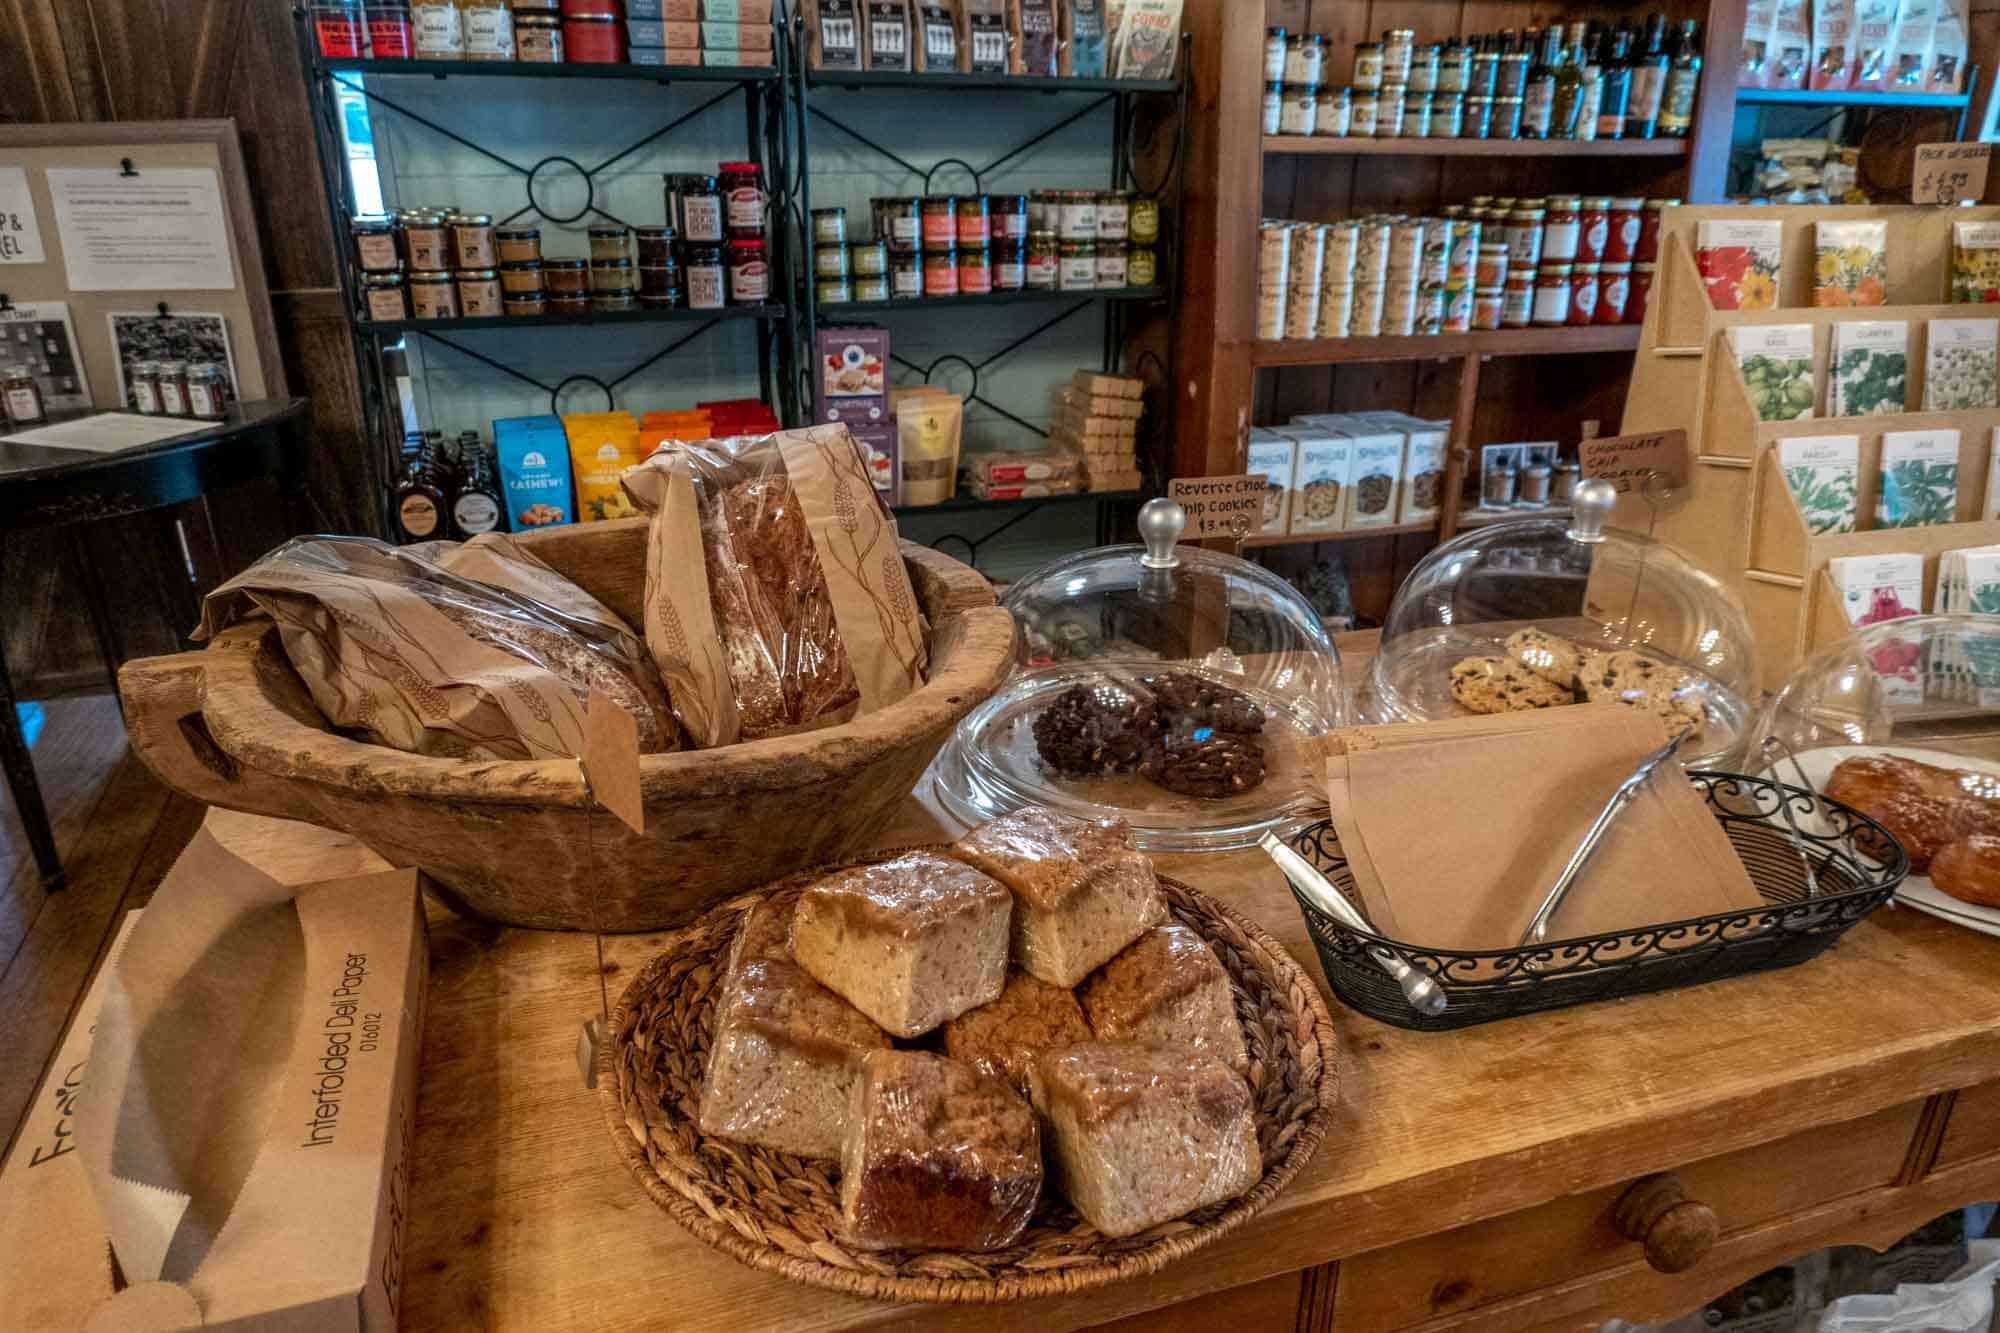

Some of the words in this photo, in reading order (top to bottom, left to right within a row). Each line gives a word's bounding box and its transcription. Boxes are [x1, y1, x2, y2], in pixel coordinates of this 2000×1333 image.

[332, 953, 368, 998] Paper
[325, 999, 359, 1029] Deli
[359, 1011, 382, 1052] 016012
[301, 1032, 352, 1148] Interfolded
